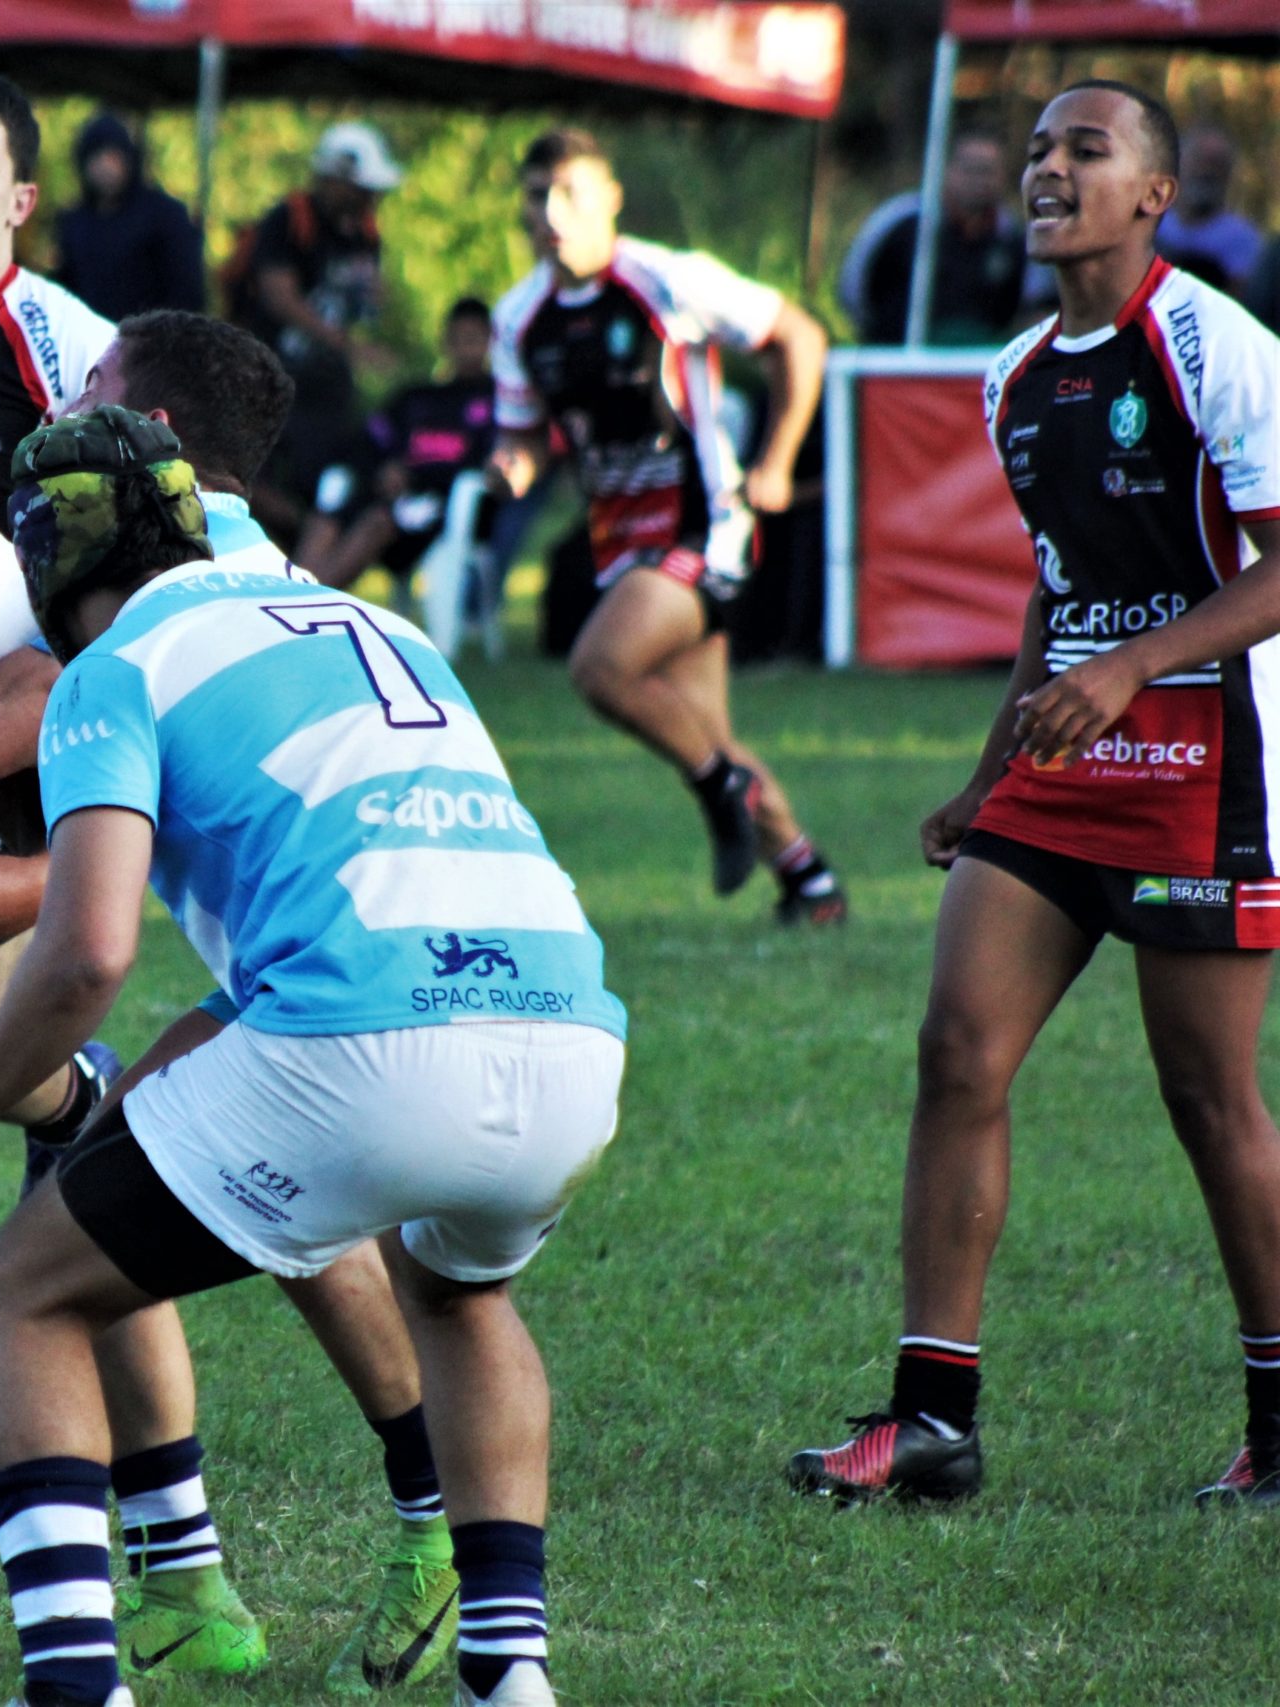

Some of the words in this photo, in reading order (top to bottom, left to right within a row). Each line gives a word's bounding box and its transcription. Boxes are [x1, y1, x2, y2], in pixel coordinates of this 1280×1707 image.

[1056, 378, 1093, 395] CNA
[259, 602, 448, 730] 7
[1083, 731, 1208, 766] ebrace
[1171, 886, 1229, 903] BRASIL
[411, 987, 484, 1012] SPAC
[488, 989, 574, 1014] RUGBY
